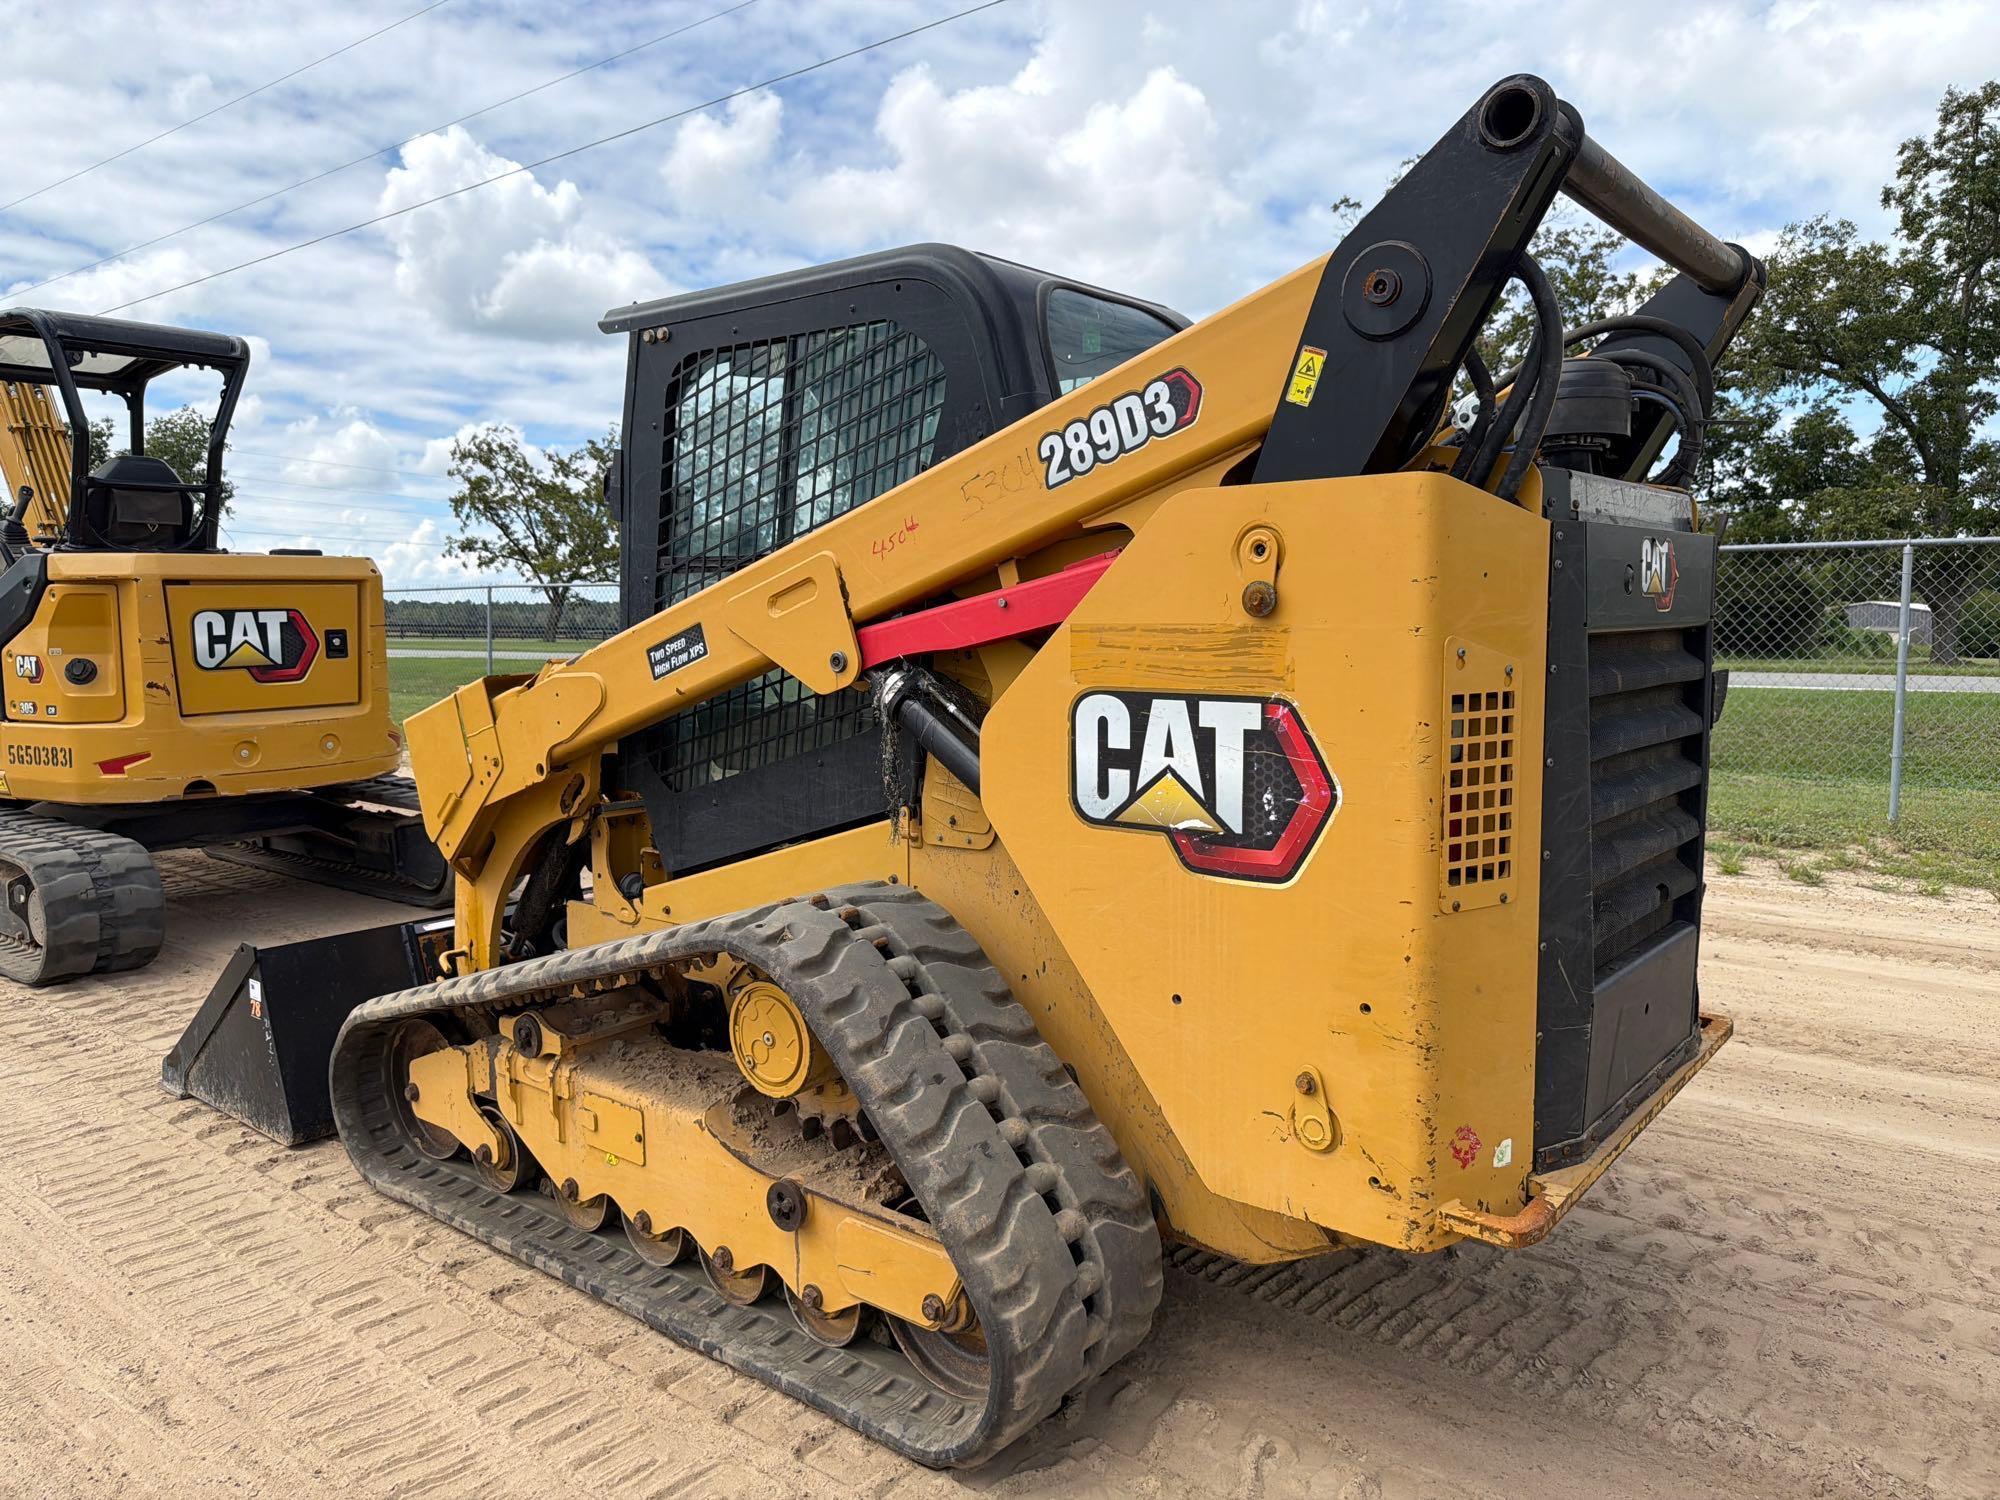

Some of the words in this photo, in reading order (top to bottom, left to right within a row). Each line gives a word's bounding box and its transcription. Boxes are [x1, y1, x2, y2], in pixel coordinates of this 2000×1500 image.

[1040, 381, 1177, 486] 289D3
[1641, 538, 1669, 594] CAT
[194, 610, 288, 669] CAT
[650, 648, 665, 663] TWO
[665, 637, 686, 656] SPEED
[654, 660, 670, 677] HIGH
[670, 651, 688, 668] FLOW
[689, 642, 704, 660] XPS
[16, 655, 37, 677] CAT
[19, 702, 34, 714] 305
[1075, 693, 1263, 836] CAT
